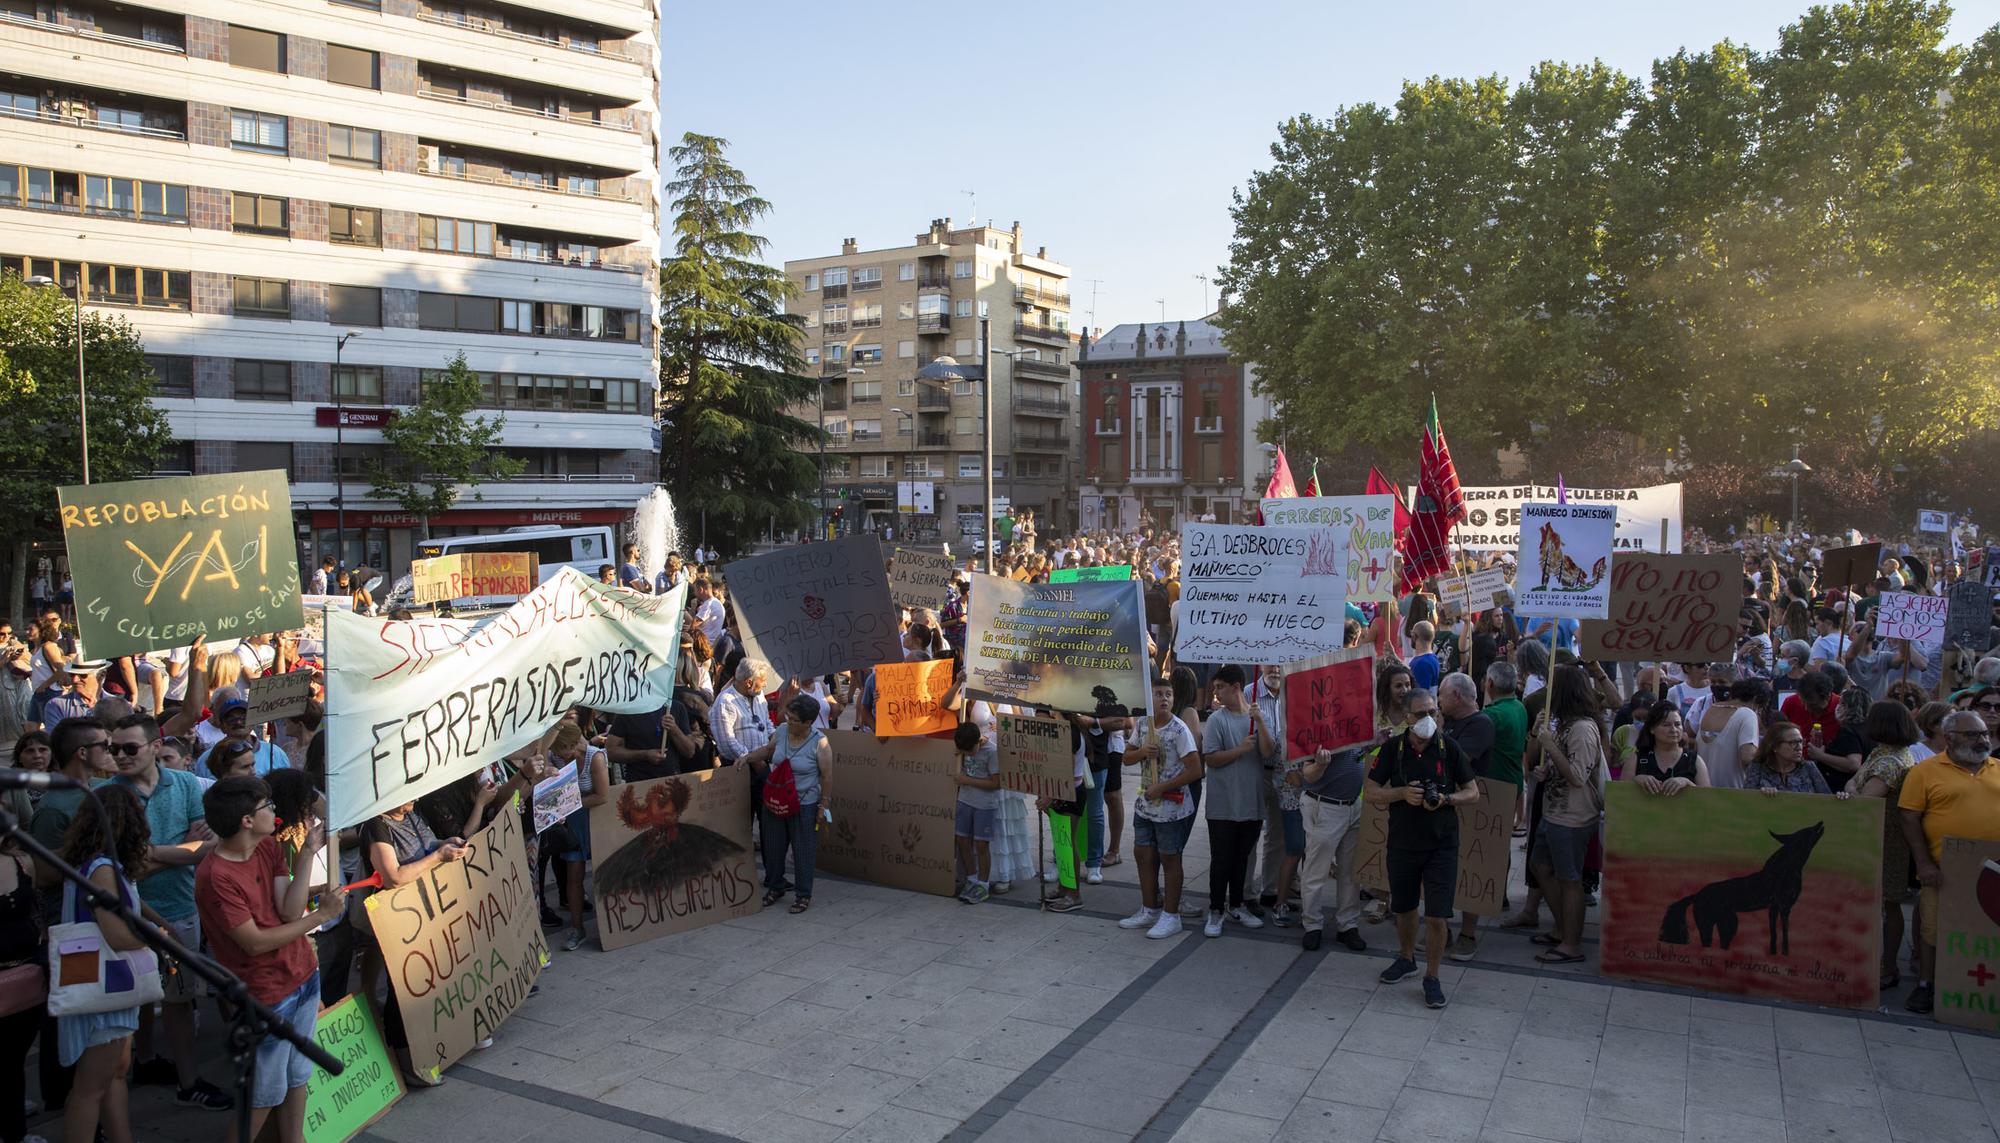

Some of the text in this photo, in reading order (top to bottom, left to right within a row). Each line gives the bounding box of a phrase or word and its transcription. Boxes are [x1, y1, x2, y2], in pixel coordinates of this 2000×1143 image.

[349, 413, 379, 421] GENERALI
[1463, 487, 1639, 501] IERRA DE LA CULEBRA
[62, 485, 270, 529] REPOBLACIÓN
[371, 514, 419, 523] MAPFR
[532, 512, 582, 522] MAPFRE
[1262, 501, 1391, 526] FERRERAS DE
[1526, 506, 1613, 520] MAÑUECO DIMISIÓN
[1223, 533, 1307, 556] DESBROCES
[414, 565, 427, 577] EL
[735, 544, 850, 590] BOMBEROS
[897, 551, 953, 572] TODOS SOMOS
[416, 573, 539, 603] JUNTA RESPONSABLE
[894, 569, 907, 581] LA
[909, 570, 939, 586] SIERRA
[1672, 569, 1720, 592] no
[87, 560, 298, 640] LA CULEBRA NO SE CALLA
[901, 592, 937, 609] CULEBRA
[1034, 590, 1075, 602] DANIEL
[1186, 585, 1319, 607] QUEMAMOS HASTA EL
[1879, 594, 1947, 613] LA SIERRA
[999, 603, 1014, 615] Tu
[1061, 611, 1066, 620] y
[1068, 610, 1110, 623] trabajo
[1190, 609, 1325, 630] ULTIMO HUECO
[1616, 600, 1648, 627] y
[1879, 607, 1946, 627] SOMOS
[746, 611, 891, 646] TRABAJOS
[993, 618, 1114, 637] hicieron que perdieras
[982, 631, 1129, 654] la vida en el incendio de la
[772, 641, 890, 682] ANUALES
[979, 646, 1132, 670] SIERRA DE LA CULEBRA
[877, 665, 915, 682] MALA
[1311, 675, 1333, 699] NO
[1311, 697, 1342, 721] NOS
[1015, 718, 1059, 739] CABRAS
[887, 754, 954, 777] AMBIENTAL
[877, 794, 954, 820] INSTITUCIONAL
[390, 809, 515, 944] SIERRA
[604, 862, 754, 934] RESURGIREMOS
[402, 861, 524, 998] QUEMADA
[1643, 943, 1691, 965] culebra
[1699, 955, 1713, 968] ni
[1723, 955, 1781, 977] perdona
[1785, 964, 1799, 977] ni
[1805, 961, 1849, 984] olvida
[433, 947, 510, 1032] AHORA
[317, 1007, 365, 1049] FUEGOS
[307, 1107, 327, 1133] EN
[331, 1061, 381, 1114] INVIERNO
